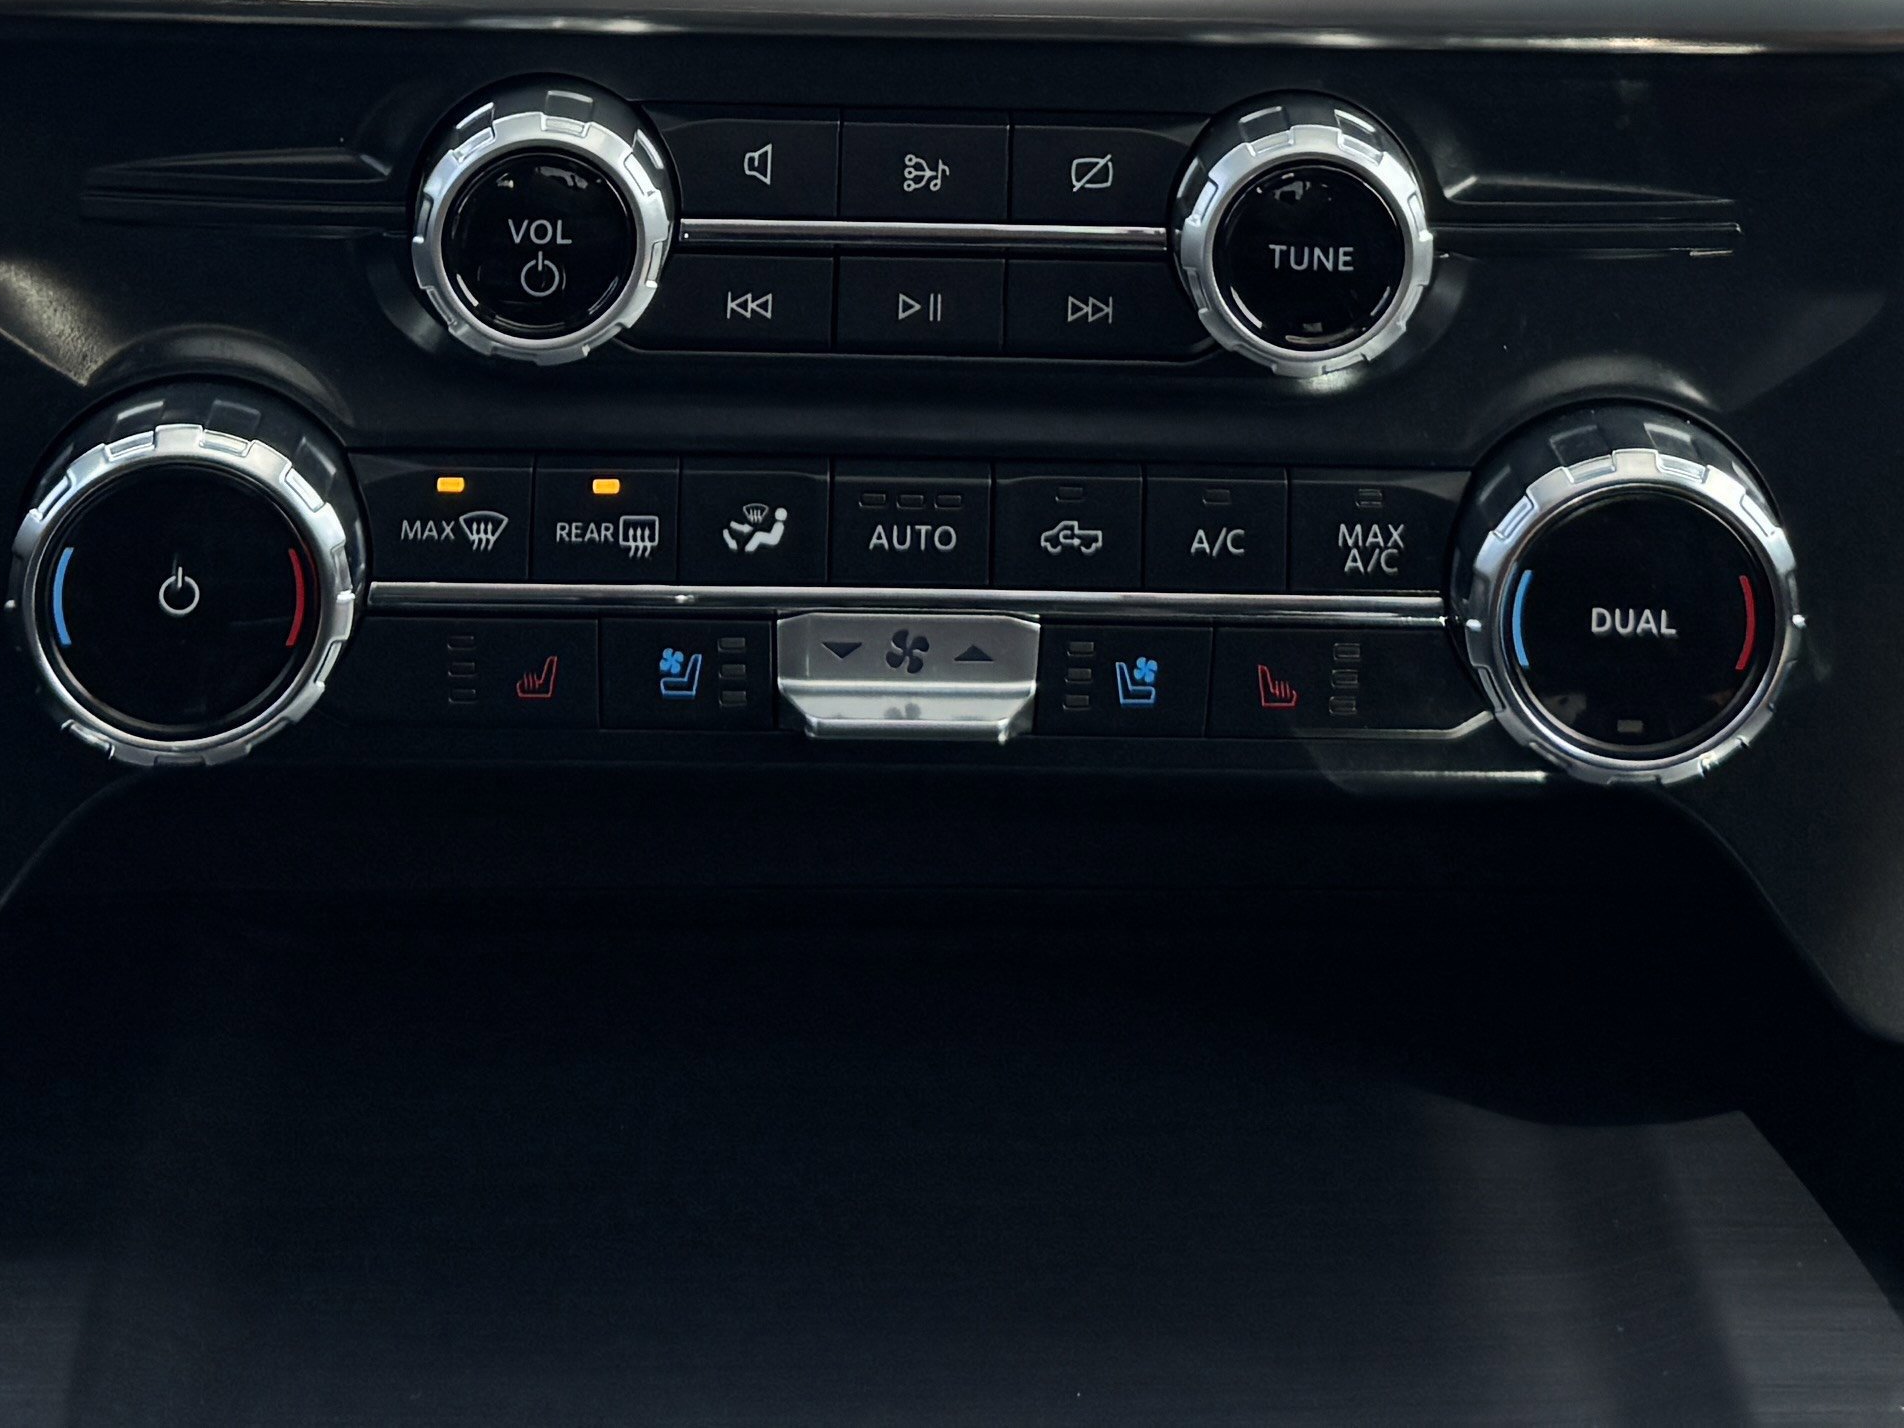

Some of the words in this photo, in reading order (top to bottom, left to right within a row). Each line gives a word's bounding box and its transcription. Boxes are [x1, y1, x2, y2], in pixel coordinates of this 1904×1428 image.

[508, 219, 572, 244] VOL
[1269, 245, 1353, 271] TUNE
[400, 518, 455, 543] MAX
[557, 523, 613, 542] REAR
[869, 525, 956, 550] AUTO
[1191, 528, 1244, 556] A/C
[1338, 523, 1405, 547] MAX
[1344, 548, 1398, 574] A/C
[1592, 608, 1676, 635] DUAL
